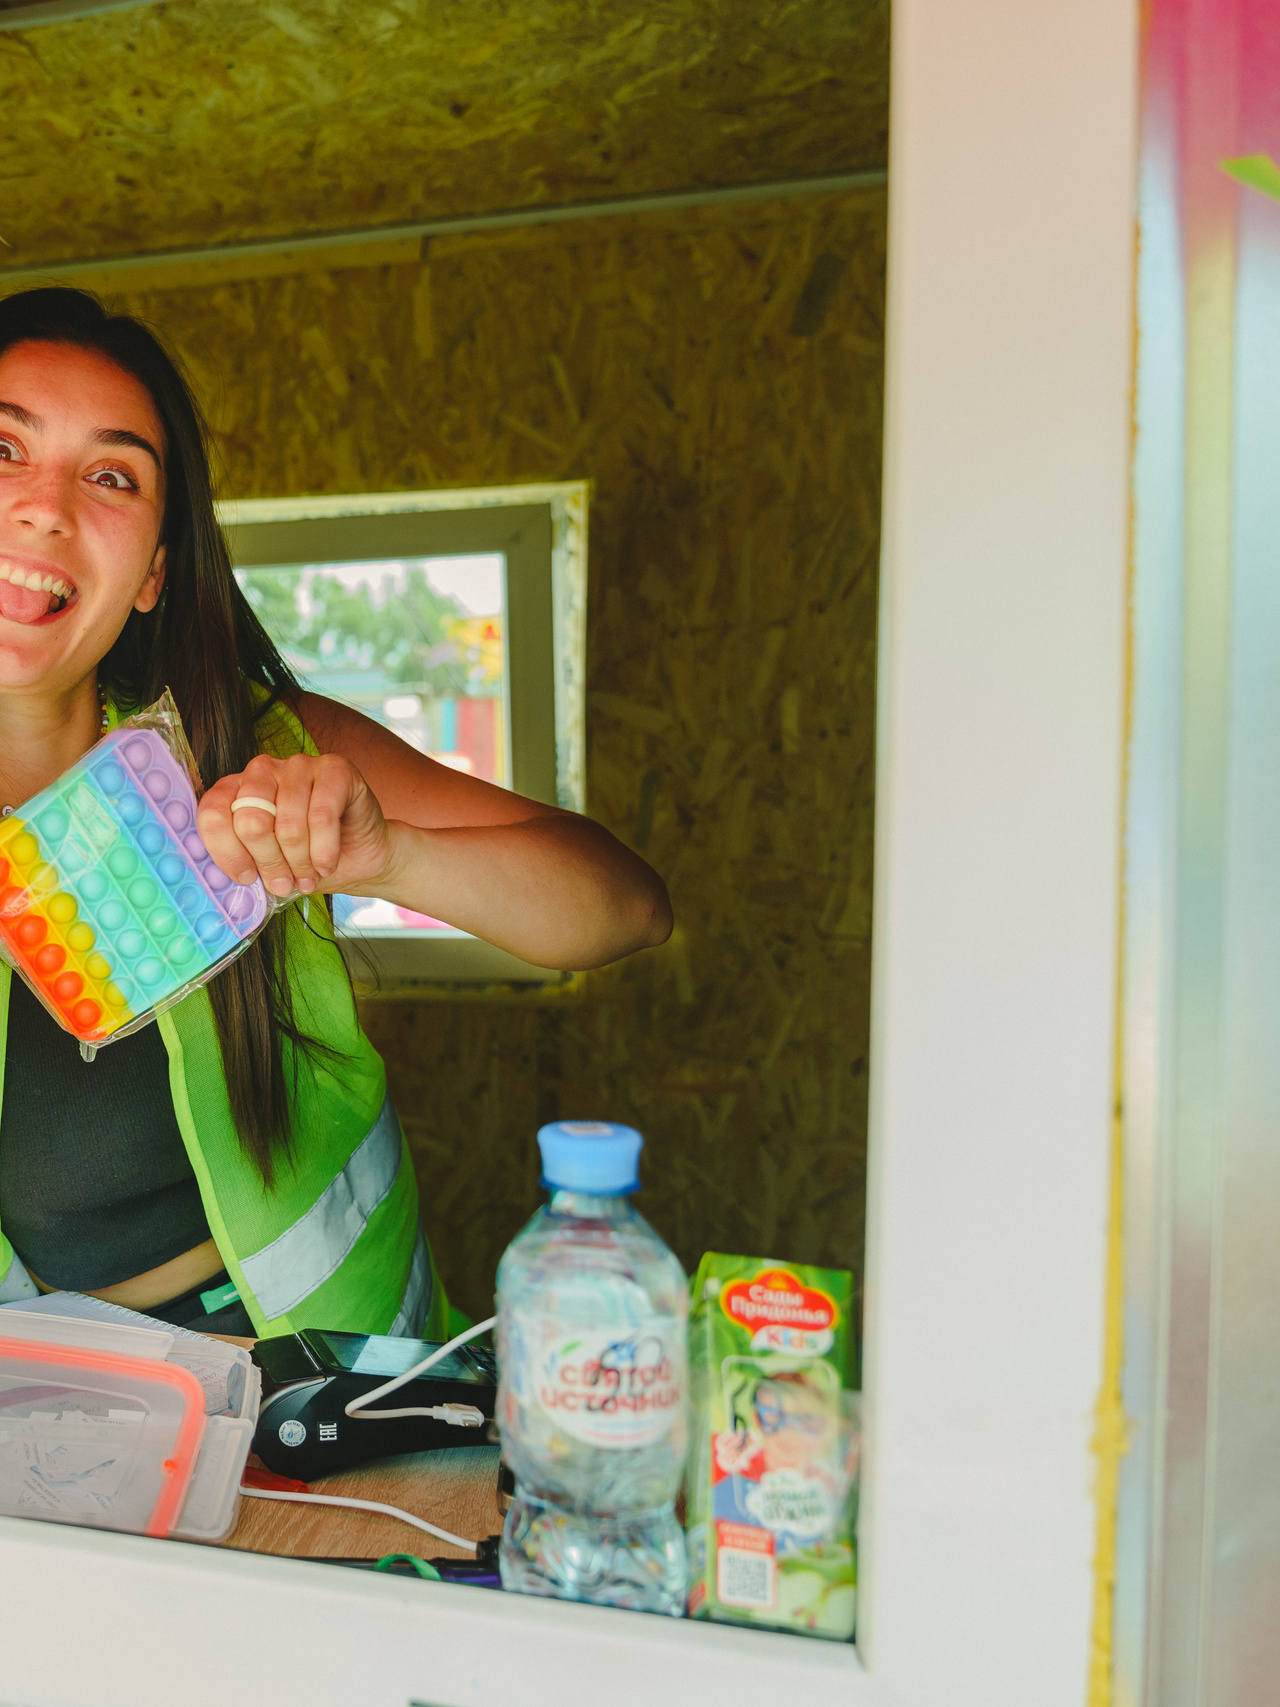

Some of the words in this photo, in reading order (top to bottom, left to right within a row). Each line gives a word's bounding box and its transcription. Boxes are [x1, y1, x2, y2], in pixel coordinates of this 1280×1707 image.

[749, 1284, 804, 1307] Сады
[731, 1295, 830, 1325] Придонья
[767, 1329, 818, 1350] Kids
